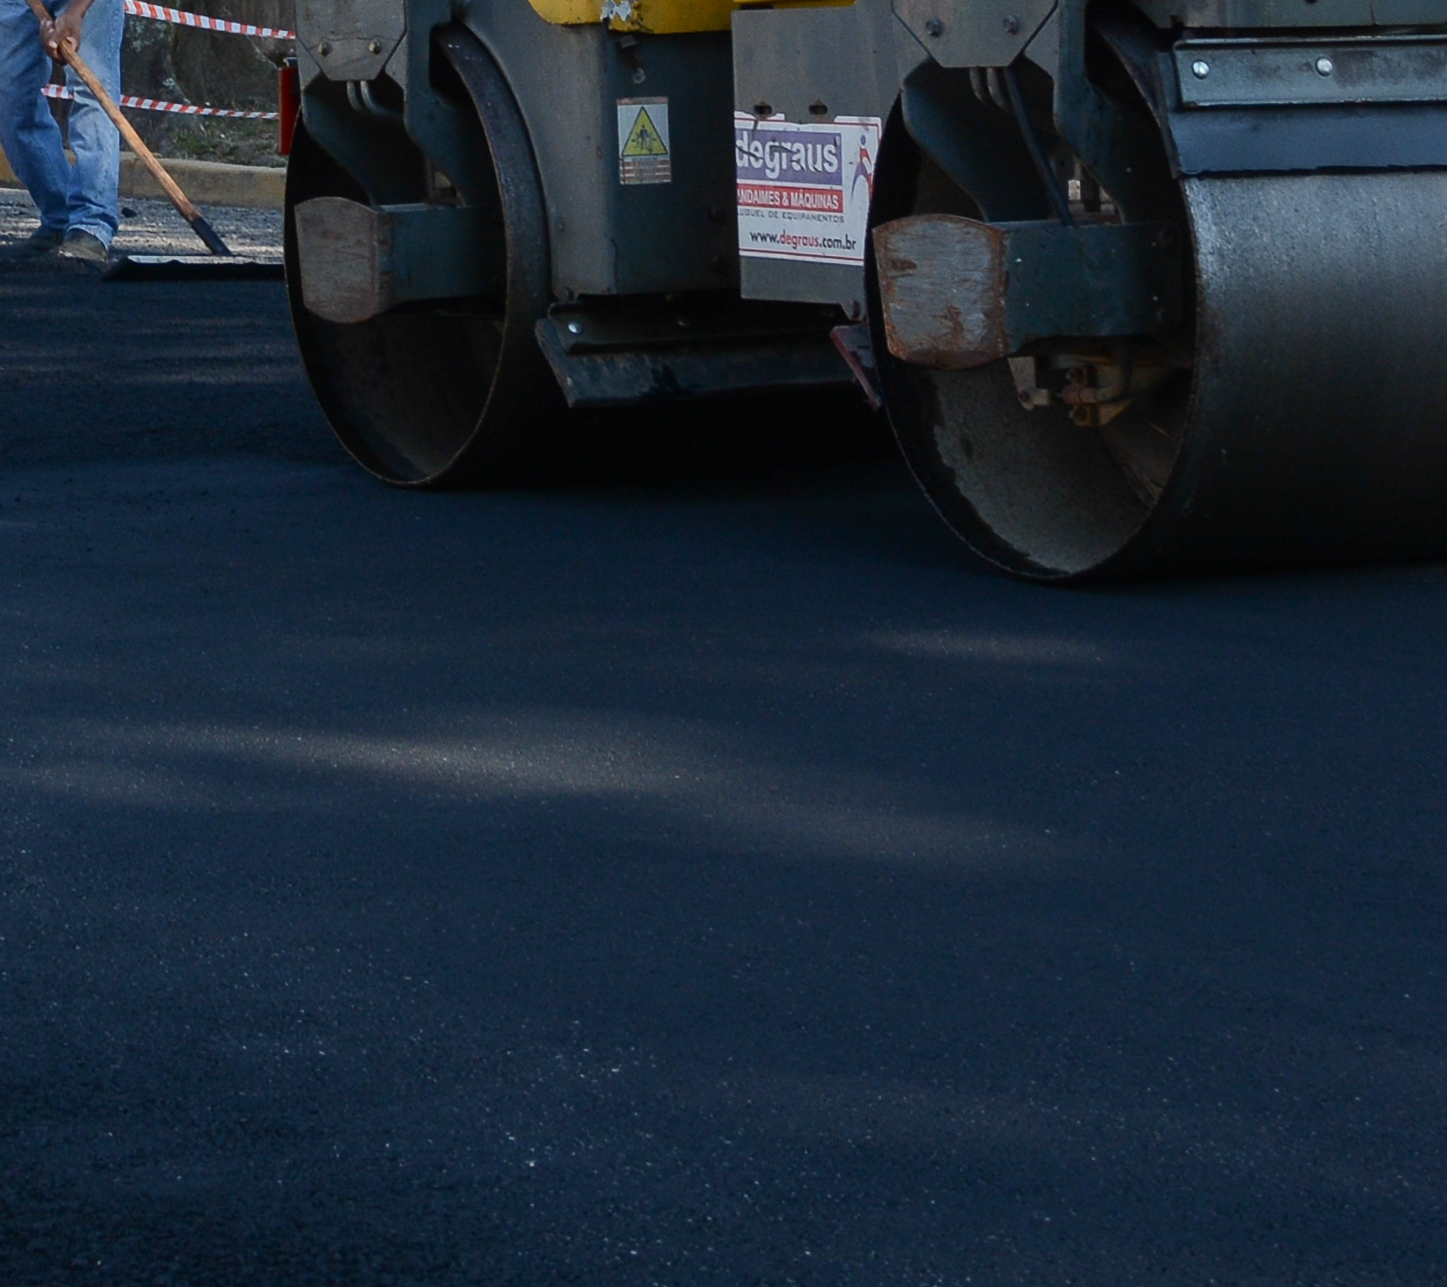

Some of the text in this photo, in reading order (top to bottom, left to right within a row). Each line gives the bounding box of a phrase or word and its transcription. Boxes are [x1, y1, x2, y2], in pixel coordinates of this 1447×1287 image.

[735, 131, 839, 179] degraus
[782, 191, 790, 206] &
[791, 189, 840, 210] MÁQUINAS
[782, 211, 845, 224] EQUIPAMENTOS
[749, 229, 857, 250] www.degraus.com.br
